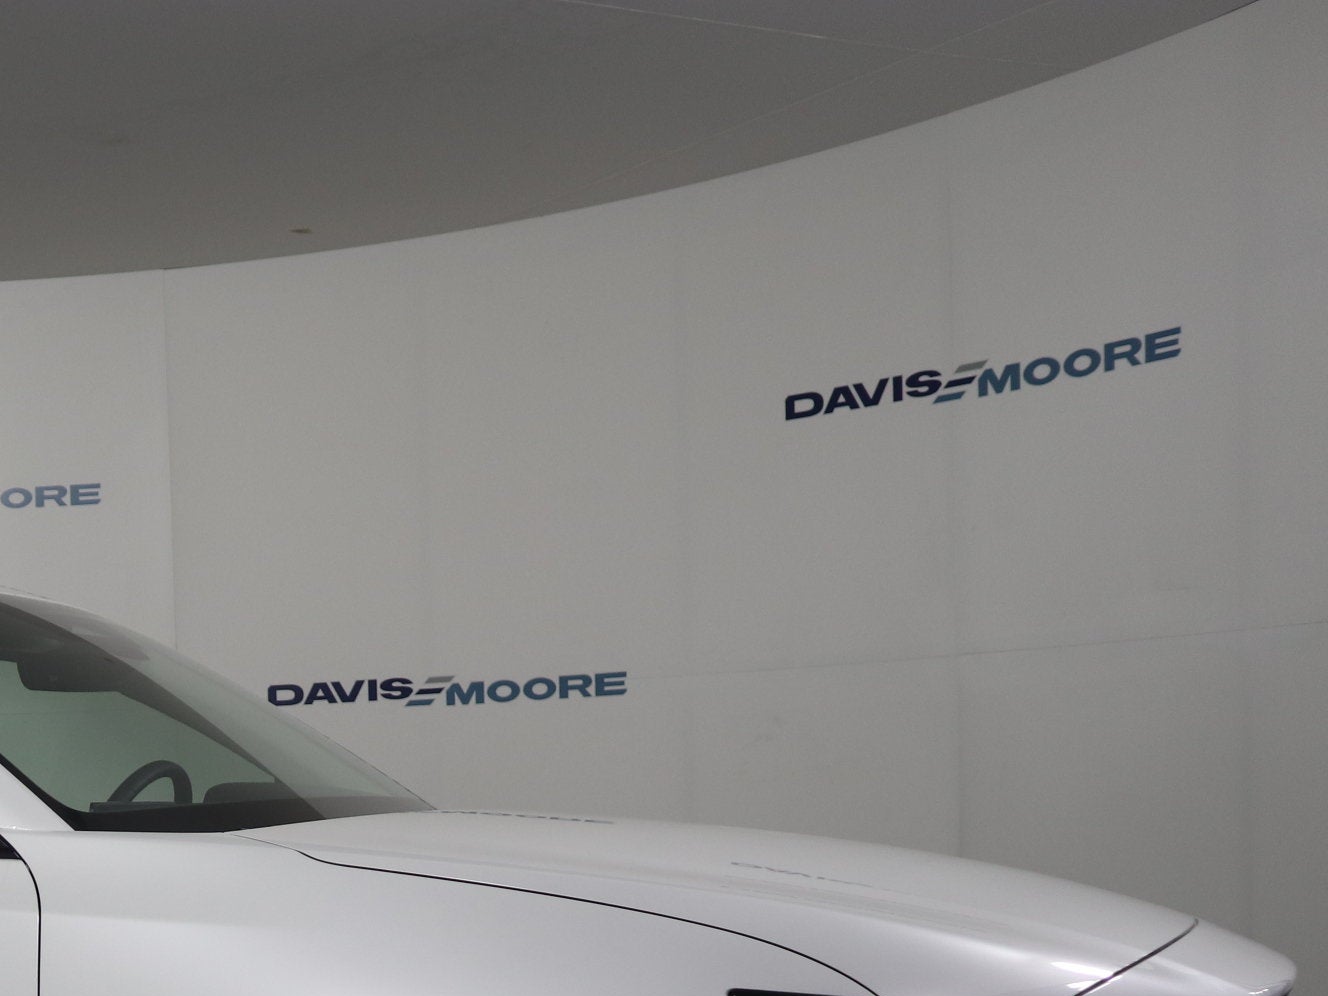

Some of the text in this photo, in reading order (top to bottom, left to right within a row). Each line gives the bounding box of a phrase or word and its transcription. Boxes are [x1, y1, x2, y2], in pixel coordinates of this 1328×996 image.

[784, 325, 1183, 422] DAVIS MOORE
[266, 670, 628, 708] DAVIS MOORE
